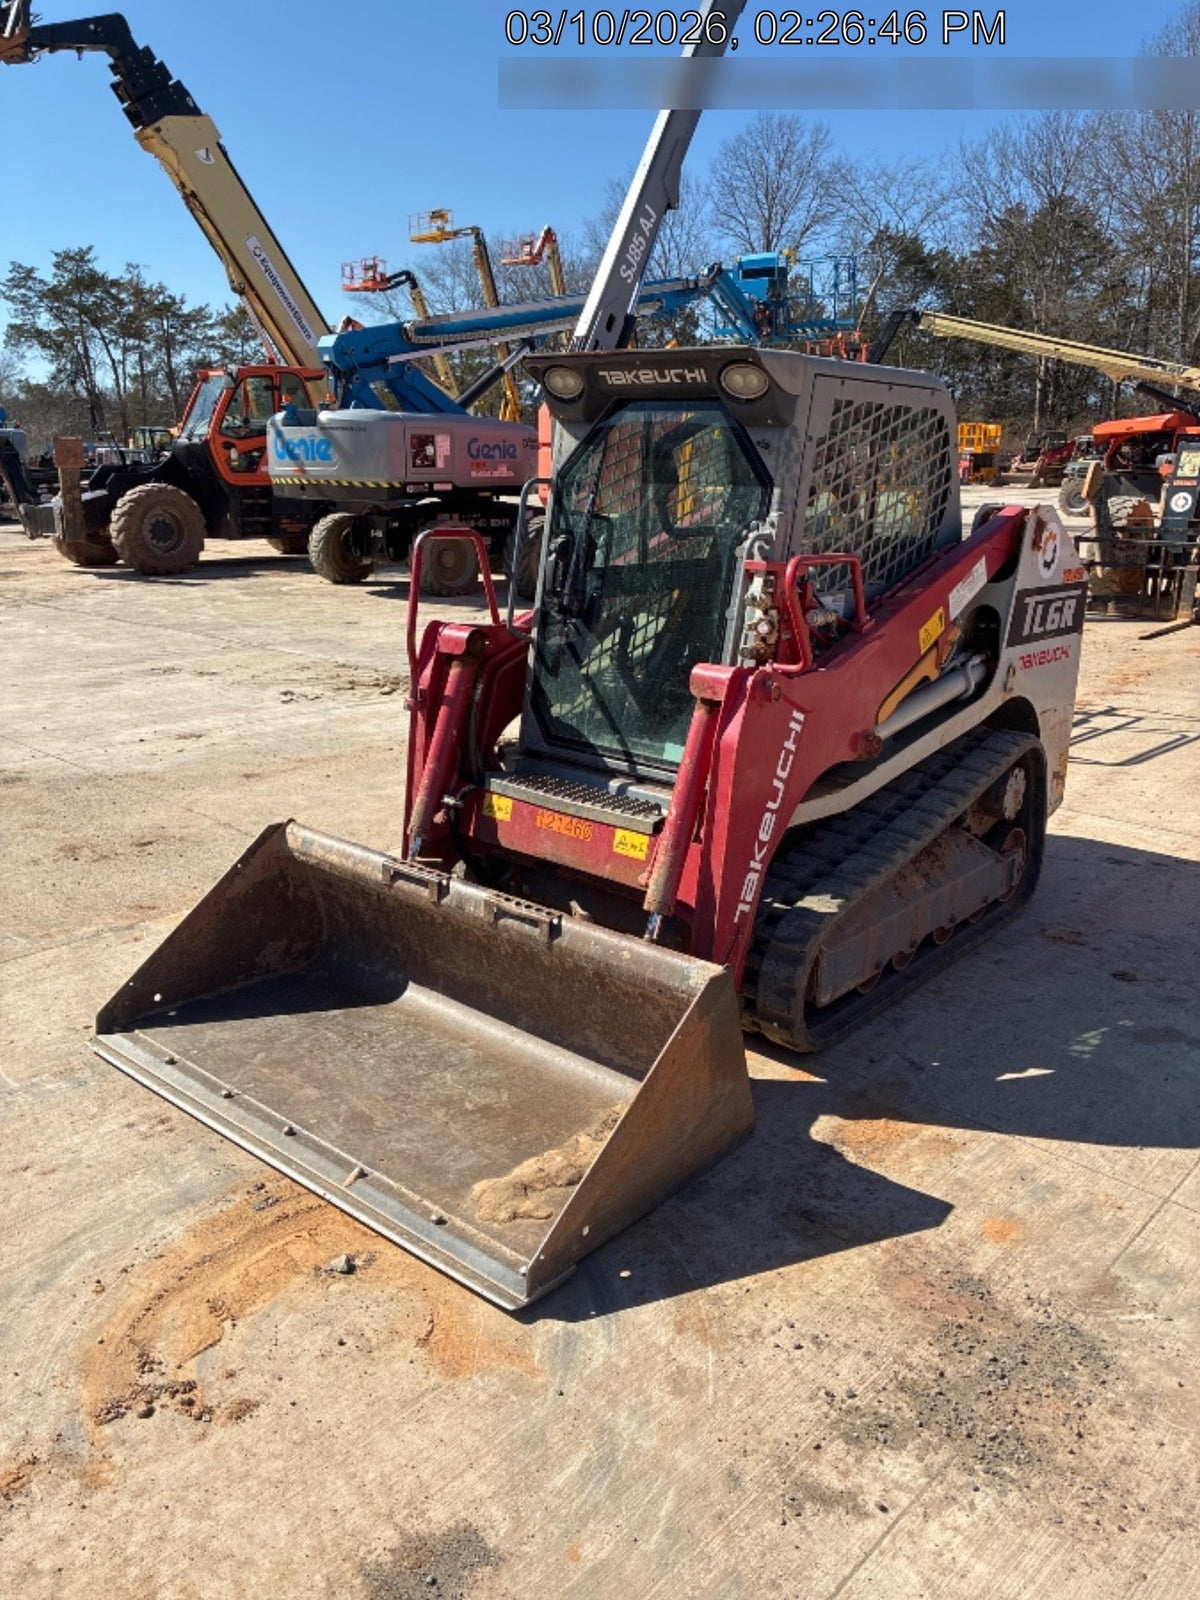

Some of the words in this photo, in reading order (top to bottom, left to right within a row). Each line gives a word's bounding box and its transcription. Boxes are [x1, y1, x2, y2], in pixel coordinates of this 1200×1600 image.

[619, 232, 647, 284] SJ85
[639, 203, 657, 238] AJ
[598, 368, 708, 385] TAKEUCHI
[272, 432, 334, 462] Genie
[467, 437, 518, 460] Genie
[1021, 589, 1082, 637] TL6R
[733, 709, 805, 924] TAKEUCHI
